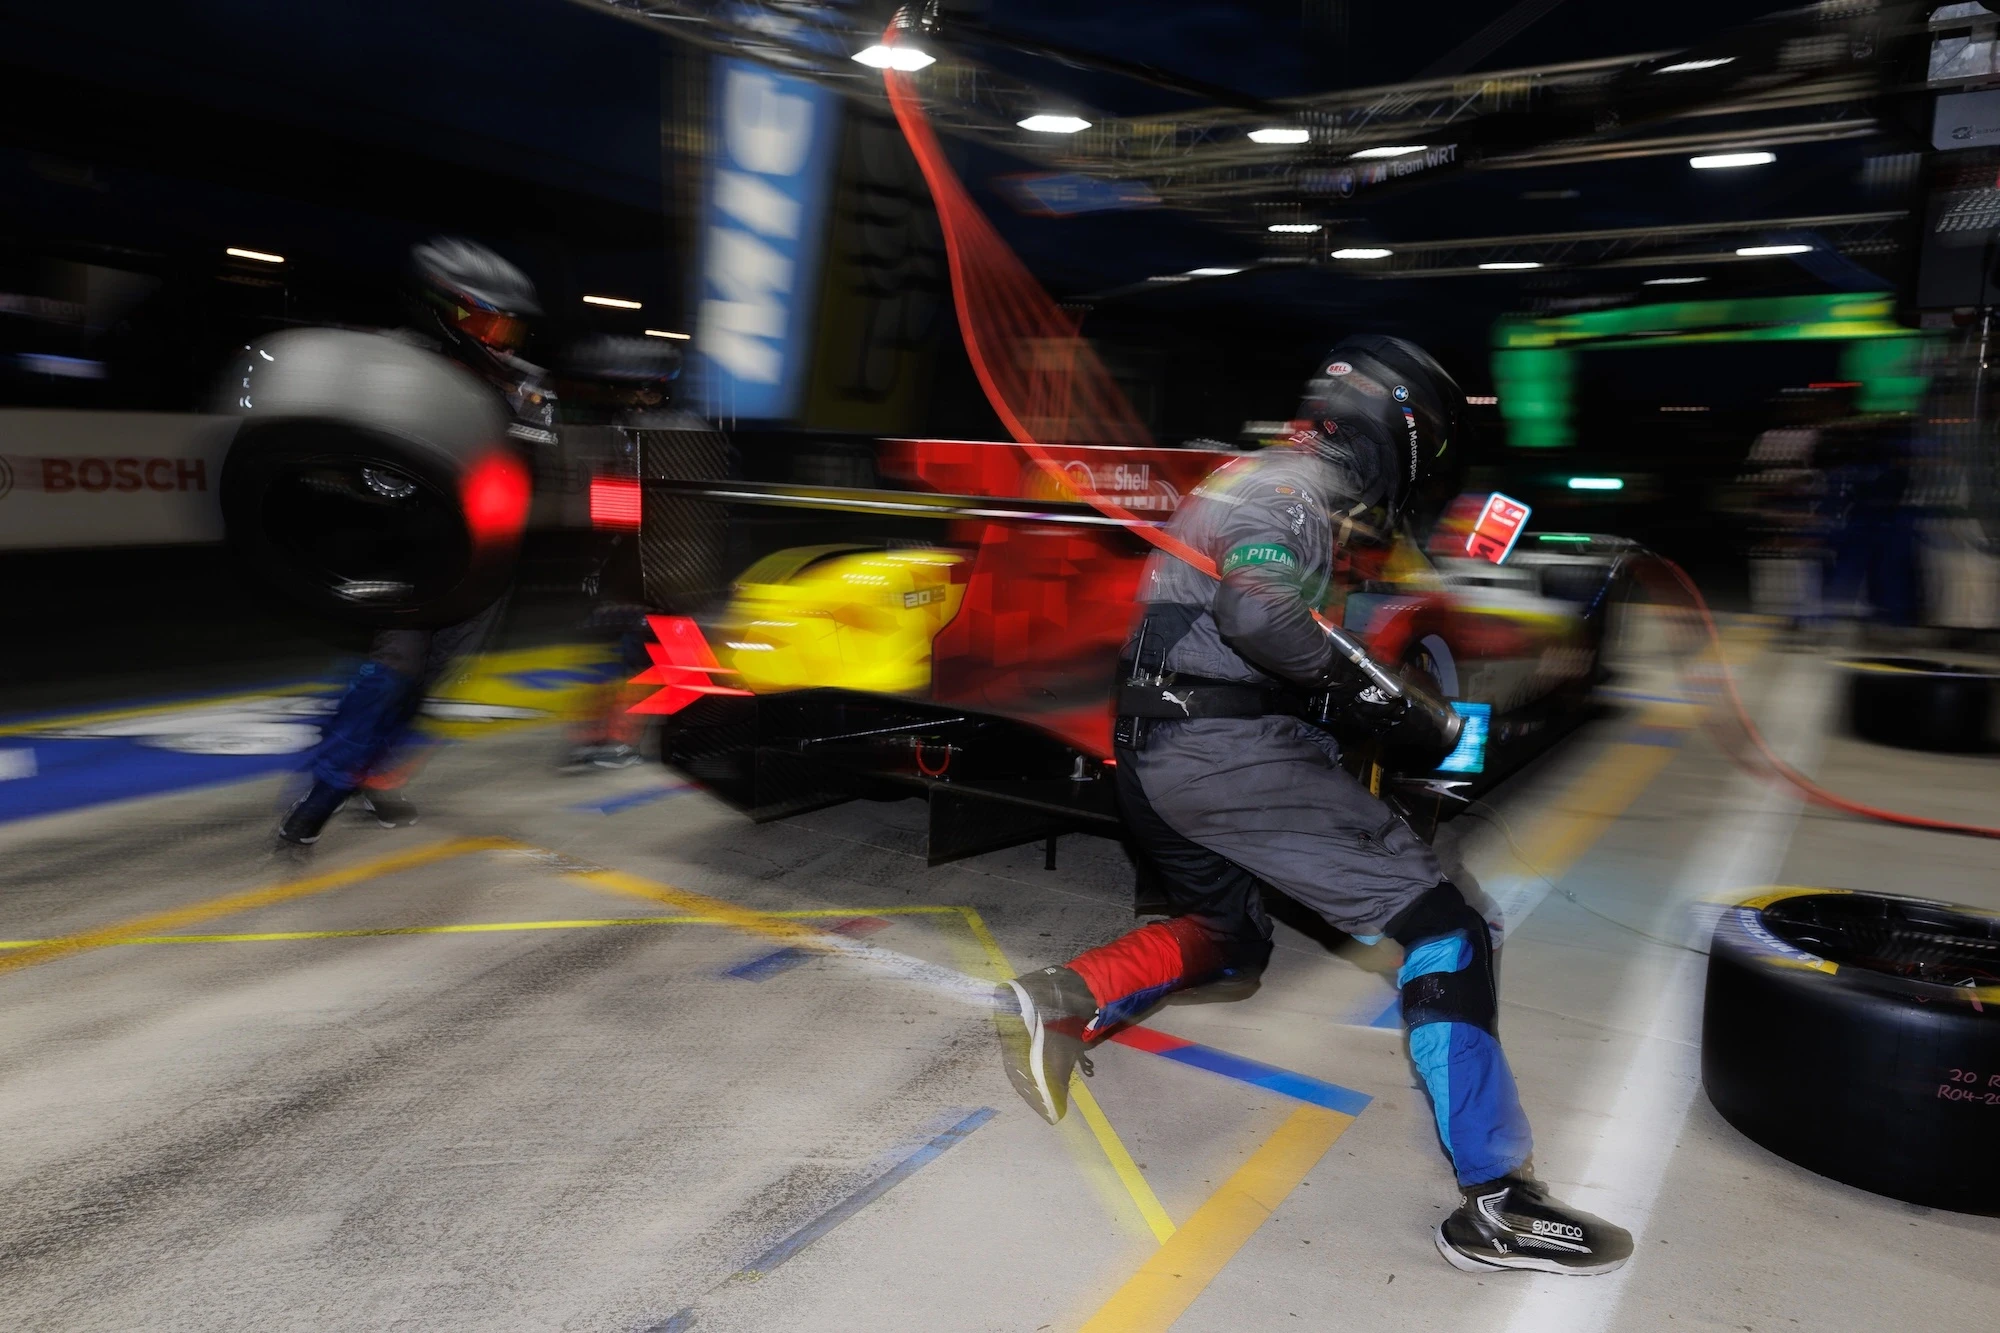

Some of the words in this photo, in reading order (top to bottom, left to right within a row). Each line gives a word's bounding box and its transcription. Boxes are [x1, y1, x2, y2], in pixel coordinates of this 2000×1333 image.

[1391, 158, 1424, 177] Team
[1426, 144, 1458, 168] WRT
[1328, 365, 1348, 373] BELL
[1408, 430, 1418, 482] Motorsport
[41, 457, 208, 494] BOSCH
[1114, 464, 1150, 491] Shell
[904, 590, 931, 608] 20
[1949, 1068, 1978, 1084] 20
[1532, 1219, 1583, 1238] sparco
